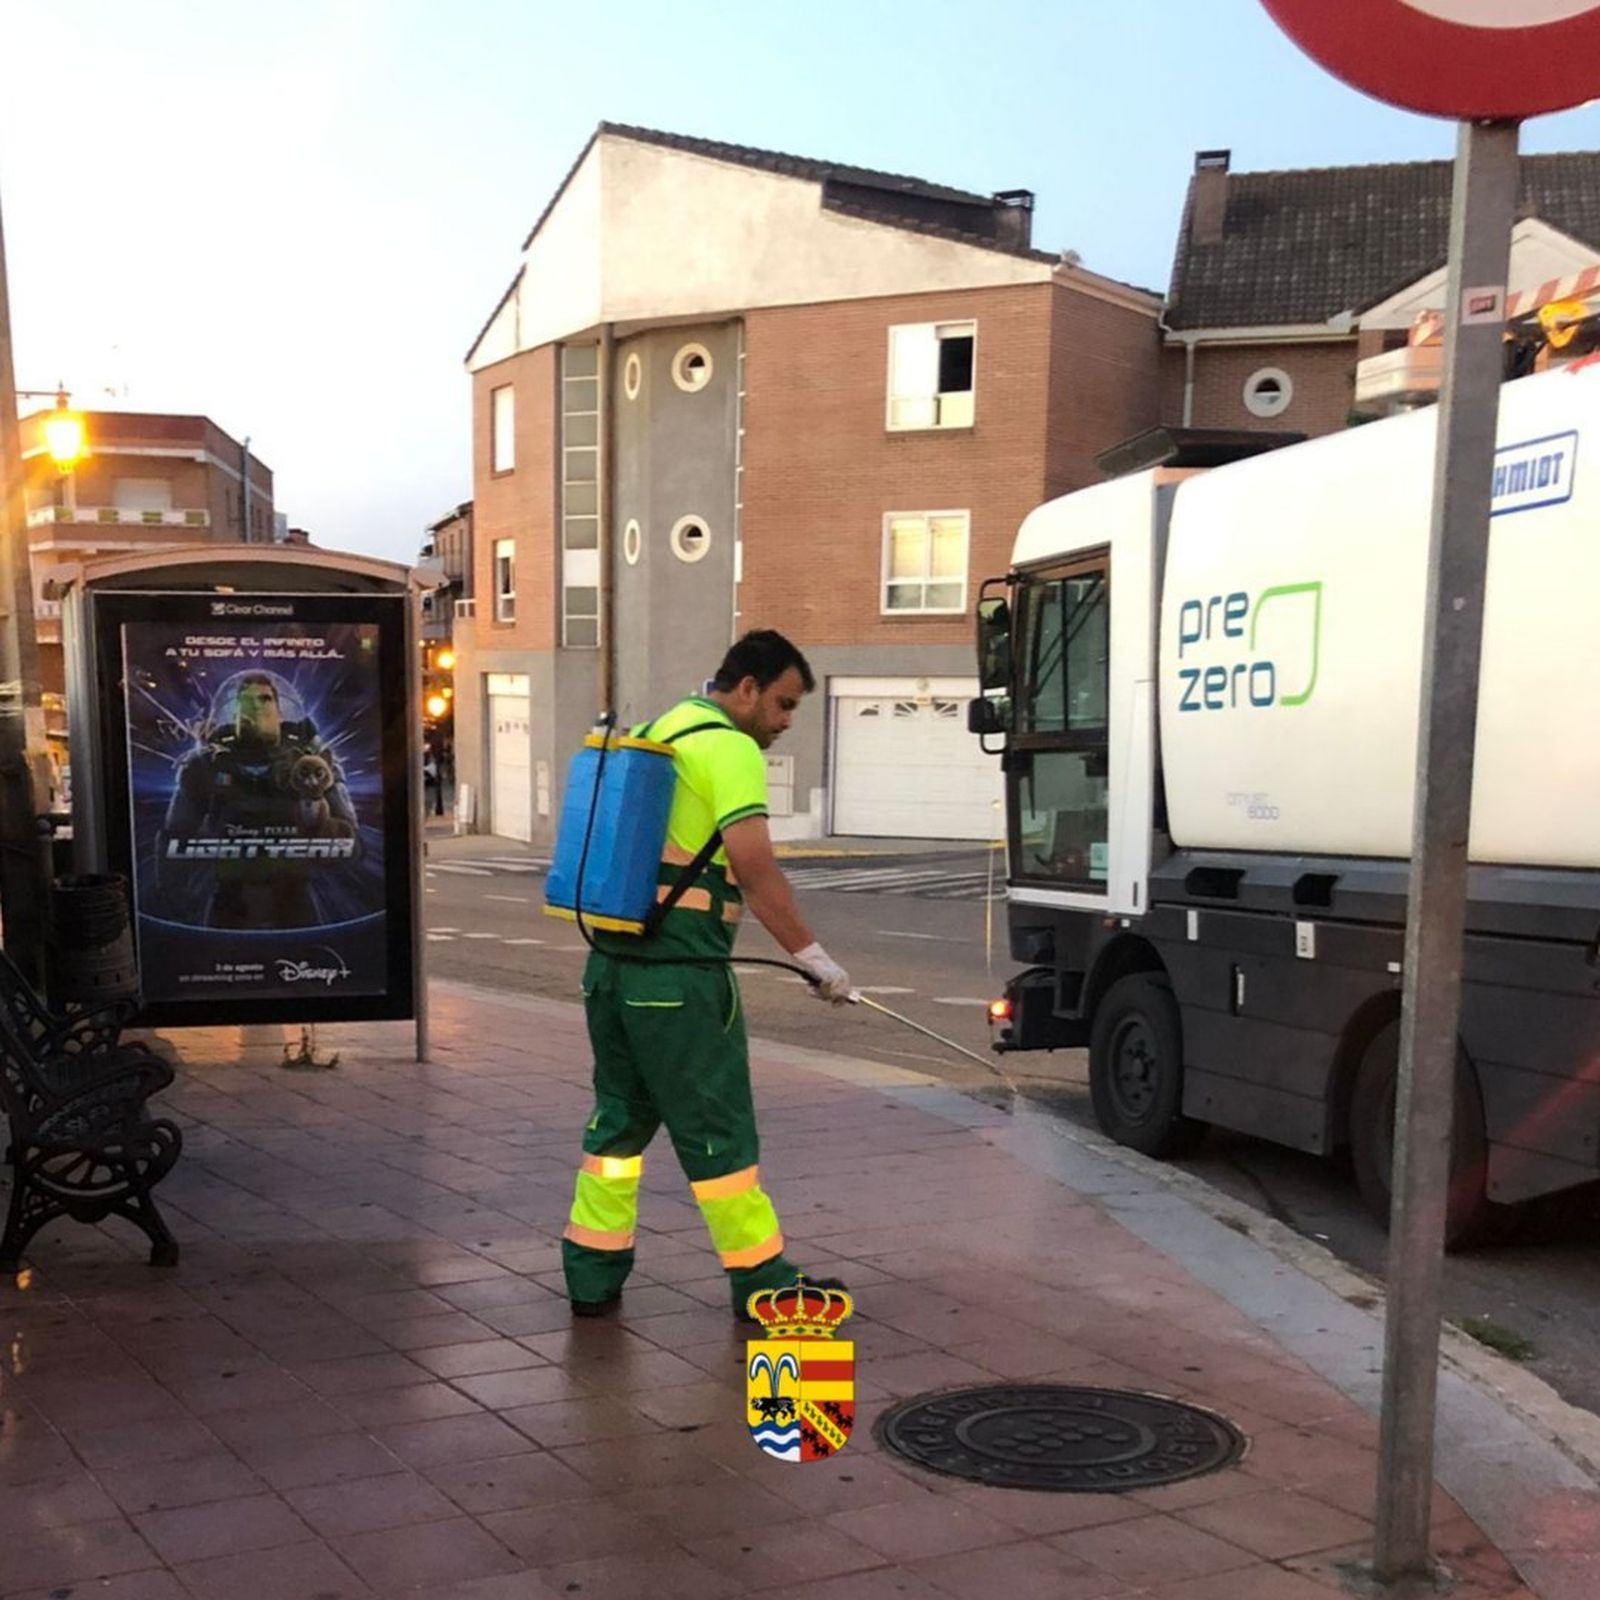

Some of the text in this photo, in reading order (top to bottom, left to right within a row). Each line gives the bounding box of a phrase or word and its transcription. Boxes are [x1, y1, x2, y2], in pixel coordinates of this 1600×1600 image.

[1492, 451, 1564, 498] HMIDT
[226, 603, 293, 615] Clear Channel
[1179, 590, 1249, 659] pre
[185, 636, 325, 647] DESDE EL INFINITO
[165, 648, 177, 657] A
[181, 648, 200, 657] TU
[203, 647, 244, 658] SOFÁ
[248, 649, 260, 658] Y
[263, 648, 296, 658] MÁS
[1178, 660, 1276, 712] zero
[165, 838, 355, 859] LIGHTYEAR
